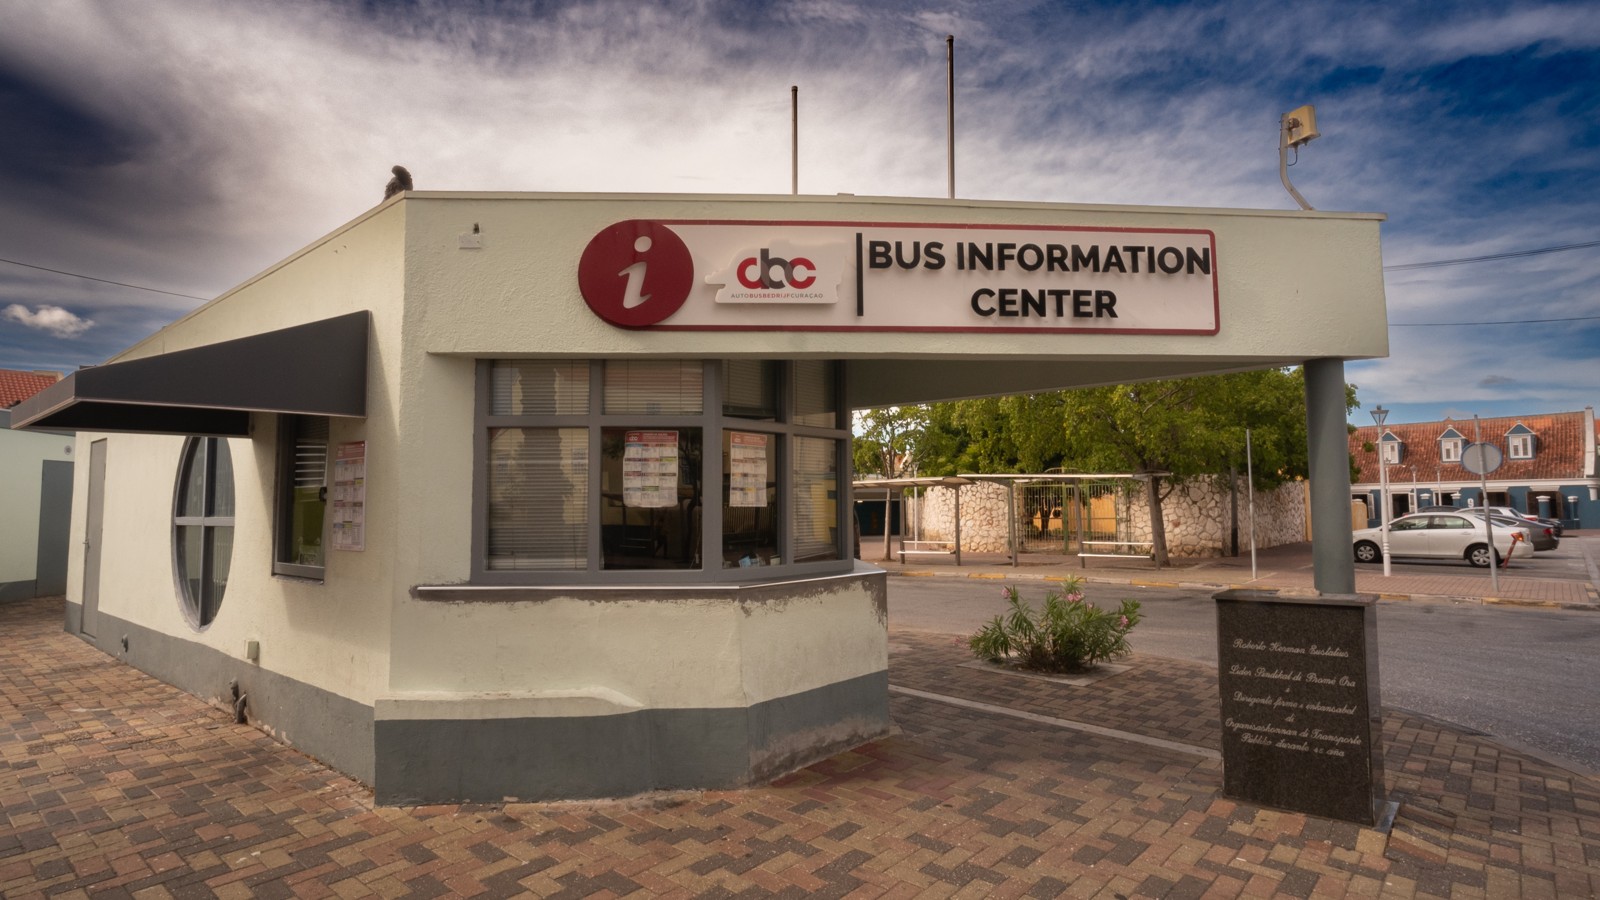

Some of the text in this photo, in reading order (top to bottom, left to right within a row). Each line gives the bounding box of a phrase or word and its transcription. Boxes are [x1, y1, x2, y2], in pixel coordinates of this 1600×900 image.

[868, 240, 1211, 276] BUS INFORMATION
[970, 288, 1118, 318] CENTER
[1232, 638, 1349, 658] Roberto Herman Eustatius
[1292, 672, 1302, 681] di
[1285, 713, 1296, 723] di
[1275, 738, 1309, 751] durante
[1299, 728, 1309, 737] di
[1310, 728, 1362, 746] Transporte
